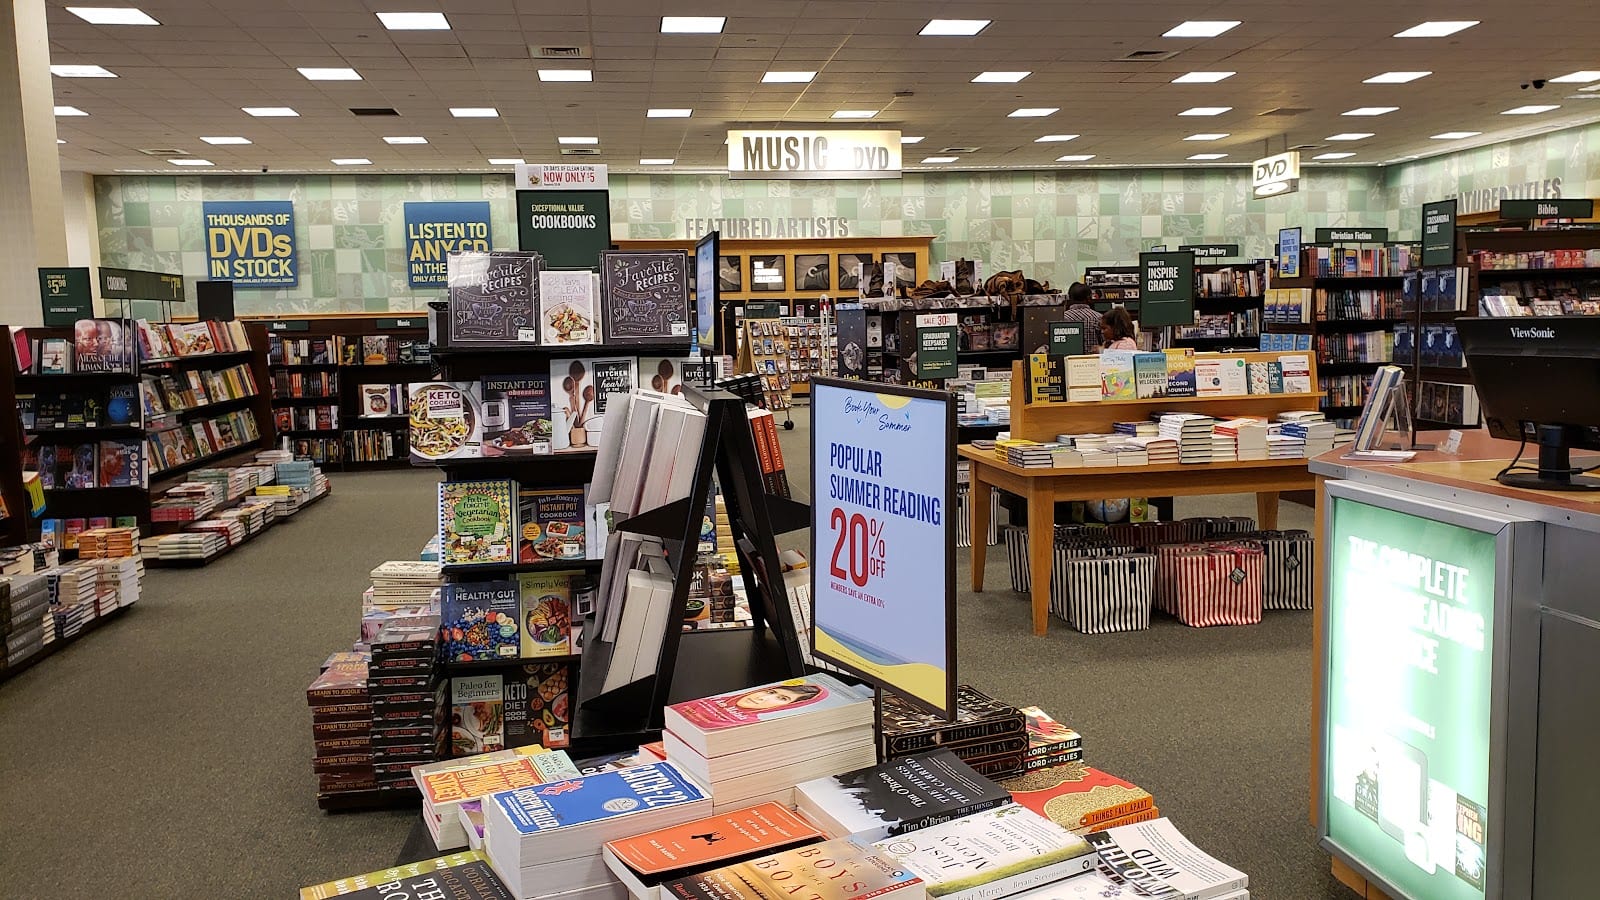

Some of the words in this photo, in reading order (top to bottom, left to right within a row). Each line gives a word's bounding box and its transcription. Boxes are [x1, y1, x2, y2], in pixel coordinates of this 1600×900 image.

[742, 136, 828, 170] MUSIC
[854, 146, 889, 170] DVD
[544, 172, 562, 183] NOW
[566, 172, 585, 183] ONLY
[1256, 160, 1287, 181] DVD
[531, 204, 567, 212] EXCEPTIONAL
[568, 204, 585, 212] VALUE
[1537, 204, 1558, 215] Bibles
[207, 214, 274, 226] THOUSANDS
[275, 213, 290, 225] OF
[531, 214, 596, 229] COOKBOOKS
[685, 218, 772, 239] FEATURED
[776, 216, 849, 238] ARTISTS
[1427, 214, 1449, 225] CASSANDRA
[409, 222, 465, 239] LISTEN
[467, 222, 487, 238] TO
[1331, 231, 1354, 240] Christian
[1355, 231, 1372, 240] Fiction
[209, 227, 292, 258] DVDs
[410, 239, 455, 261] ANY
[211, 259, 230, 278] IN
[233, 258, 293, 278] STOCK
[412, 263, 423, 274] IN
[424, 263, 447, 274] THE
[1148, 267, 1179, 279] INSPIRE
[107, 276, 127, 291] COOKING
[481, 277, 522, 294] RECIPES
[636, 273, 675, 291] RECIPES
[1148, 280, 1174, 292] GRADS
[273, 322, 287, 330] Music
[397, 319, 410, 327] Music
[1510, 327, 1555, 338] ViewSonic
[487, 381, 526, 390] INSTANT
[528, 381, 545, 389] POT
[429, 391, 460, 400] KETO
[844, 396, 862, 414] Book
[878, 414, 912, 432] Summer
[830, 442, 882, 478] POPULAR
[539, 503, 564, 511] INSTANT
[830, 474, 880, 511] SUMMER
[884, 486, 941, 526] READING
[539, 511, 577, 519] COOKBOOK
[830, 507, 886, 588] 20%
[870, 557, 886, 579] OFF
[456, 592, 495, 601] HEALTHY
[496, 589, 515, 598] GUT
[830, 580, 848, 596] MEMBERS
[848, 587, 857, 599] SAVE
[864, 593, 876, 606] EXTRA
[458, 690, 500, 698] Beginners
[460, 682, 483, 690] Paleo
[504, 683, 527, 700] KETO
[504, 701, 527, 710] DIET
[1027, 747, 1047, 757] LORD
[1058, 739, 1078, 750] FLIES
[1027, 759, 1047, 769] LORD
[1058, 752, 1078, 763] FLIES
[895, 765, 932, 791] THINGS
[904, 757, 946, 788] CARRIED
[618, 763, 688, 806] CATCH-22
[878, 771, 910, 796] O'Brien
[907, 792, 927, 808] Tim
[928, 788, 951, 804] THE
[942, 786, 971, 804] THEY
[512, 788, 542, 811] JOSEPH
[527, 807, 560, 829] HELLER
[902, 822, 919, 833] Tim
[920, 814, 950, 829] O'Brien
[957, 805, 969, 814] THE
[970, 801, 994, 812] THINGS
[1091, 809, 1114, 823] THINGS
[1115, 805, 1128, 817] FALL
[1129, 800, 1148, 812] APART
[986, 831, 1022, 852] Bryan
[989, 822, 1047, 856] Stevenson
[922, 845, 964, 869] Just
[935, 835, 994, 871] Mercy
[1092, 836, 1125, 869] THE
[798, 848, 868, 893] BOYS
[1132, 848, 1181, 880] WILD
[980, 886, 1004, 900] Mercy
[1013, 878, 1032, 889] Bryan
[1034, 868, 1068, 884] Stevenson
